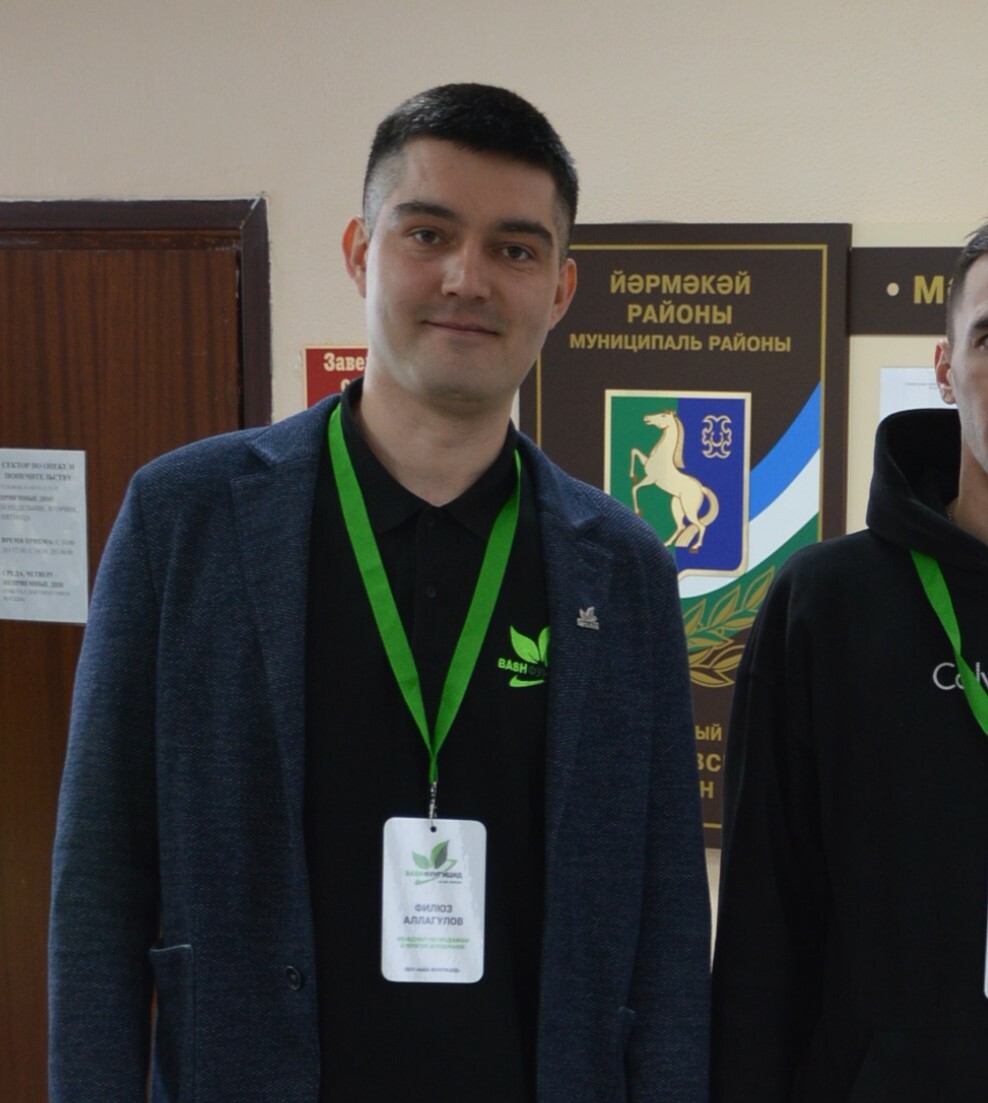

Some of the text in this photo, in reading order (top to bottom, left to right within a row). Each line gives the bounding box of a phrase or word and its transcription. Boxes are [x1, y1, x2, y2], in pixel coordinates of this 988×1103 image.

[610, 270, 750, 295] ЙӘРМӘКӘЙ
[627, 300, 732, 324] РАЙОНЫ
[570, 333, 791, 352] МУНИЦИПАЛЬ РАЙОНЫ
[323, 352, 366, 372] Заве
[414, 904, 453, 913] ФИЛЮЗ
[403, 915, 464, 926] АЛЛАГУЛОВ
